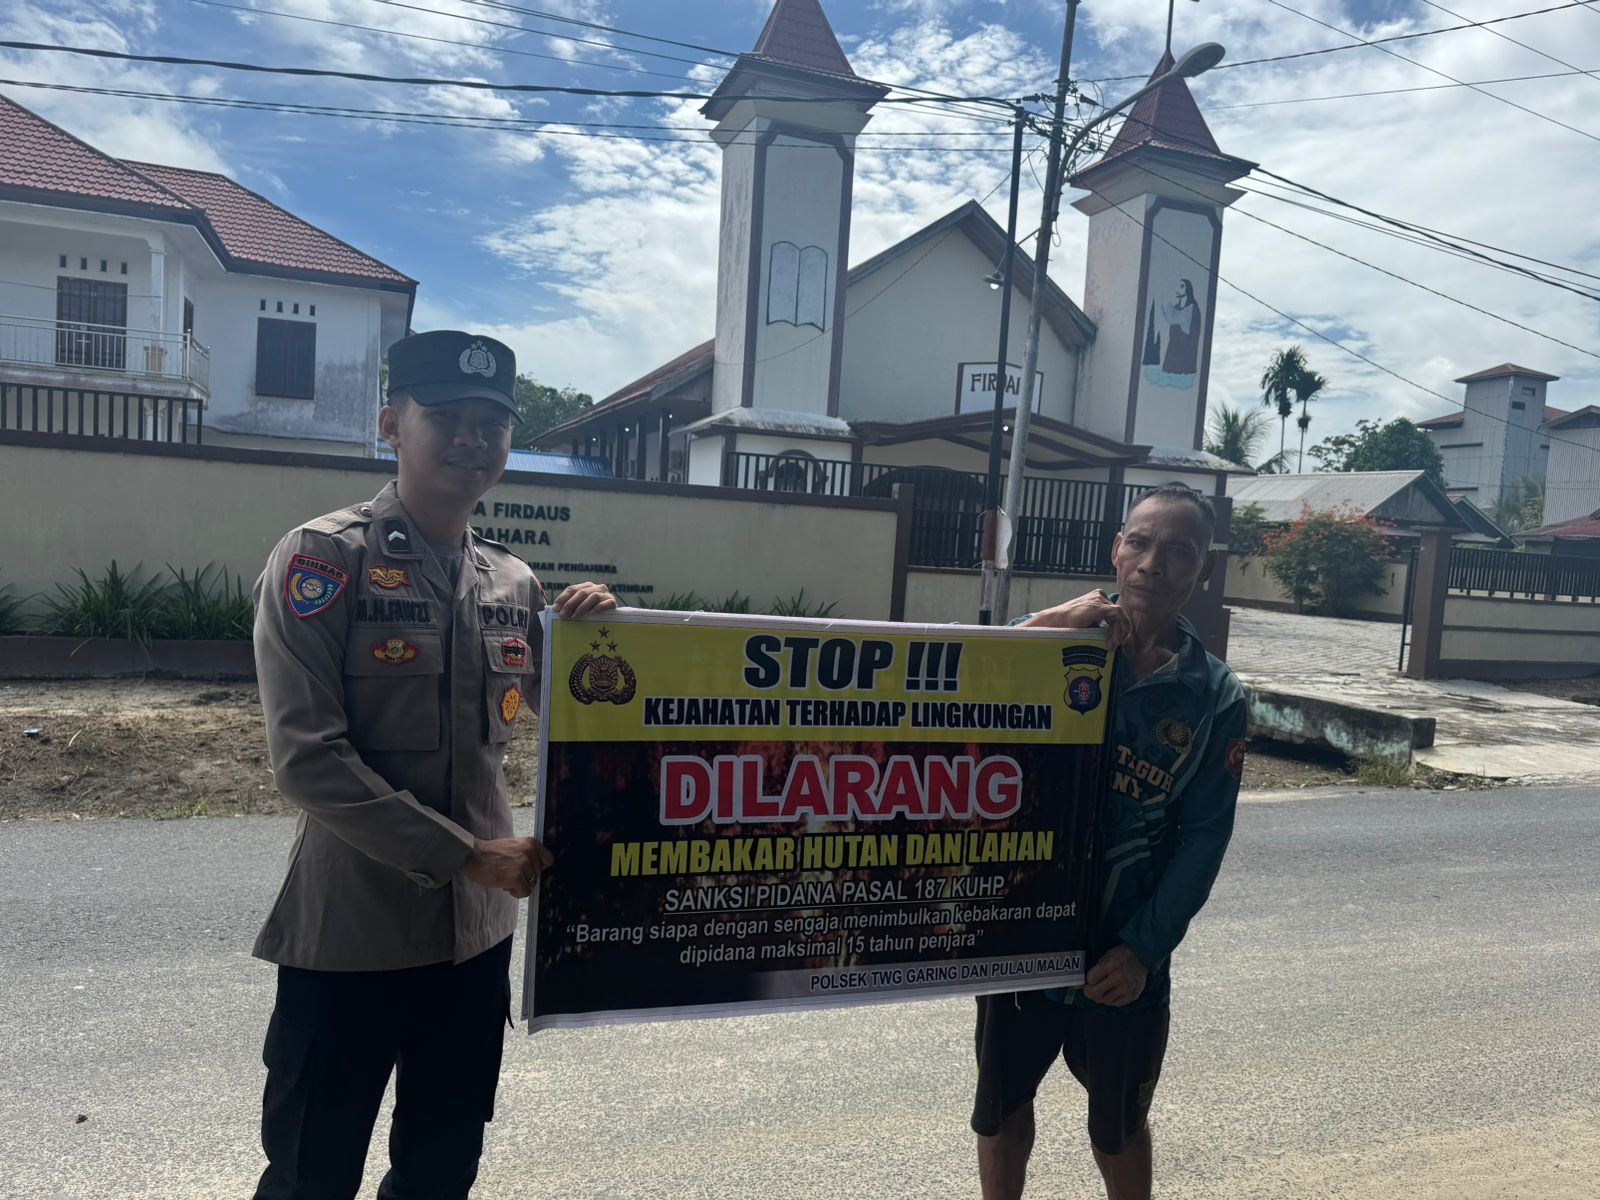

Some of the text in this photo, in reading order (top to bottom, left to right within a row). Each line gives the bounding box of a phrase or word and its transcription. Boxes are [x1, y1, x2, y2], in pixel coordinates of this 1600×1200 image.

[494, 502, 571, 521] FIRDAUS
[297, 558, 343, 579] BINMAS
[557, 562, 617, 574] PENDAHARA
[482, 606, 528, 629] POLRI
[743, 634, 964, 692] STOP !!!
[644, 697, 1052, 730] KEJAHATAN TERHADAP LINGKUNGAN
[659, 755, 1023, 826] DILARANG
[610, 831, 1054, 877] MEMBAKAR HUTAN DAN LAHAN
[665, 876, 1005, 912] SANKSI PIDANA PASAL 187 KUHP
[649, 921, 698, 942] siapa
[703, 918, 768, 939] dengan
[774, 913, 838, 935] sengaja
[844, 908, 953, 929] menimbulkan
[955, 904, 1031, 924] kebakaran
[1036, 901, 1077, 921] dapat
[680, 944, 755, 967] dipidana
[761, 937, 841, 960] maksimal
[846, 936, 865, 954] 15
[869, 935, 914, 953] tahun
[810, 956, 1081, 990] POLSEK TWG GARING DAN PULAU MALAN
